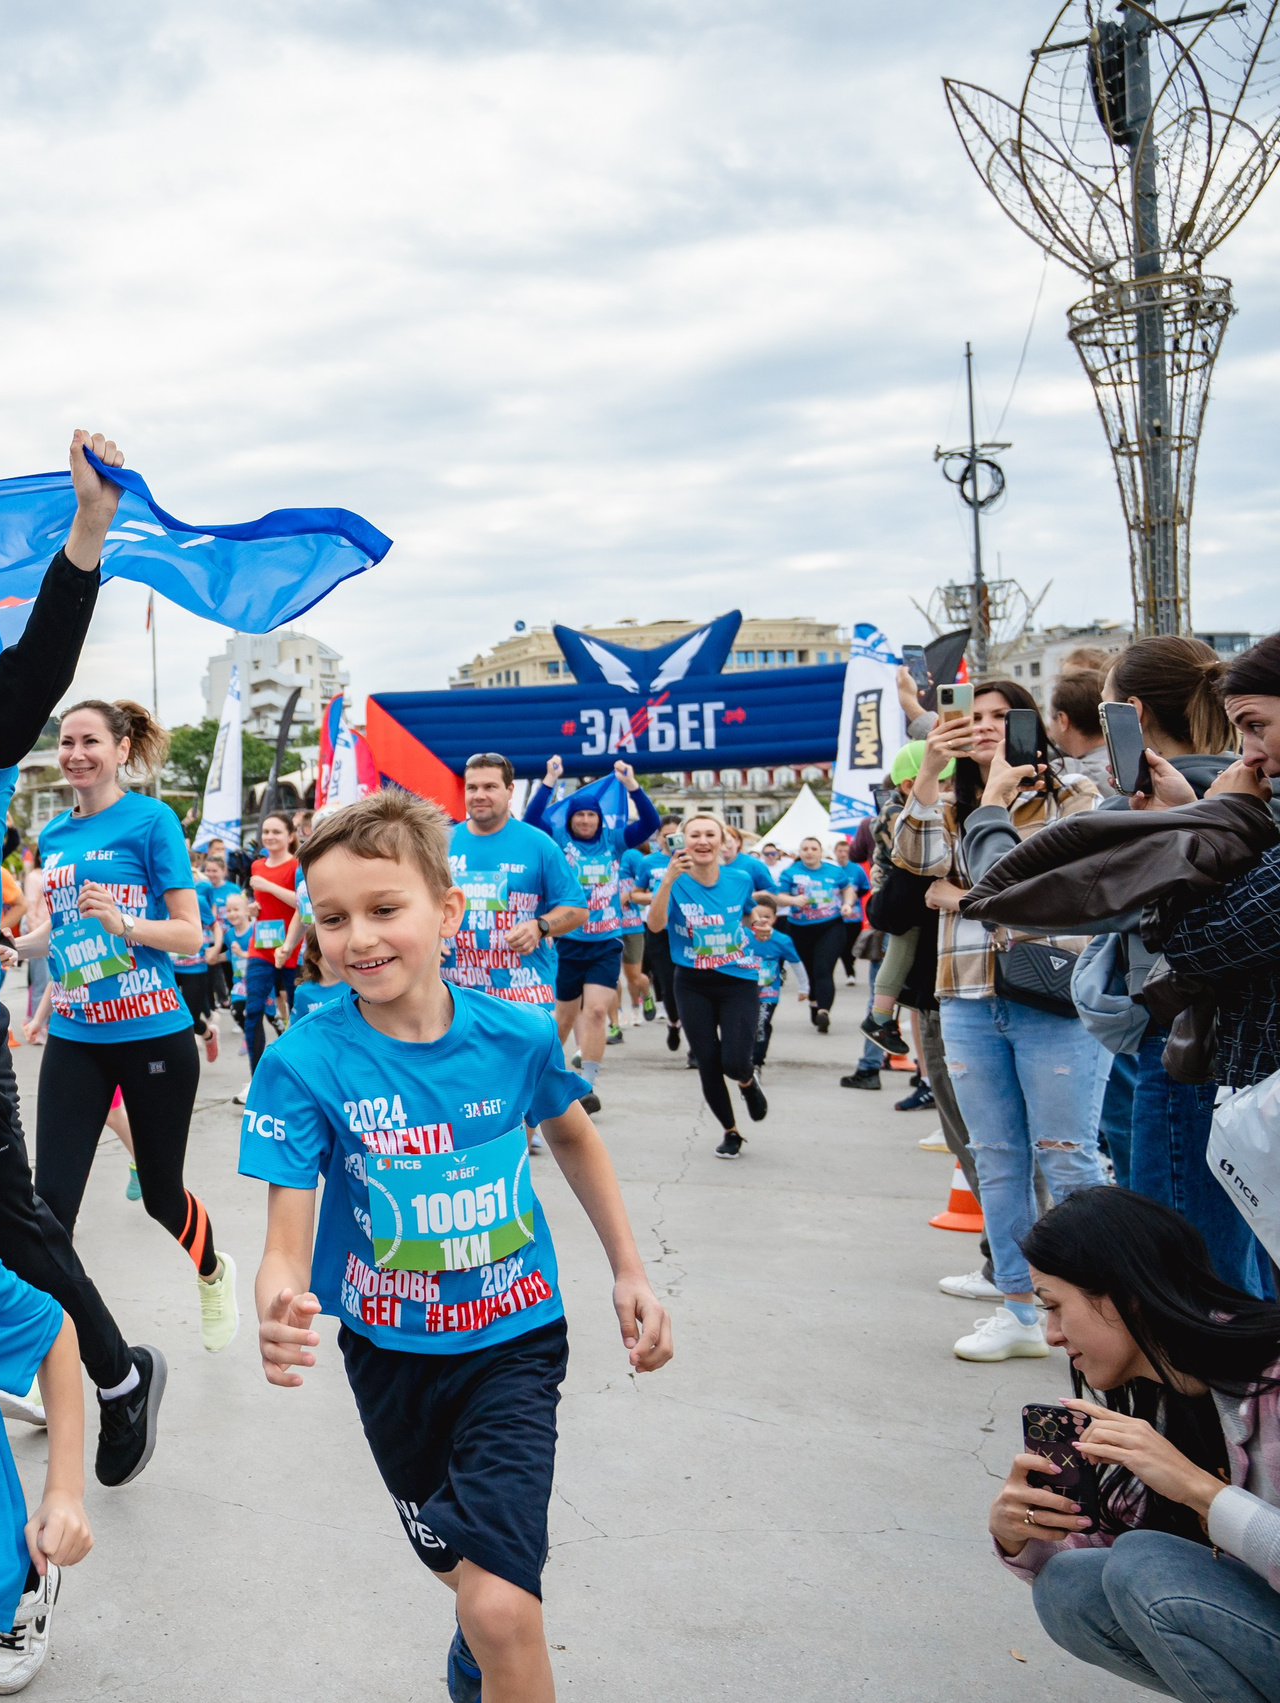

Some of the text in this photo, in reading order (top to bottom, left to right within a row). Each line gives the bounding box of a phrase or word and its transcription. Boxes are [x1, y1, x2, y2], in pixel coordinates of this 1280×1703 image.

[462, 883, 496, 898] 10062
[64, 934, 107, 967] 10184
[117, 967, 162, 997] 2024
[509, 967, 541, 987] 2024
[82, 987, 180, 1024] #ЕДИНСТВО
[343, 1094, 408, 1132] 2024
[360, 1123, 455, 1155] #МЕЧТА
[393, 1159, 422, 1170] ПСБ
[411, 1176, 508, 1235] 10051
[1233, 1175, 1260, 1208] ПСБ
[345, 1251, 440, 1303] #ЛЮБОВЬ
[341, 1269, 553, 1333] #ЗАБЕГ #ЕДИНСТВО
